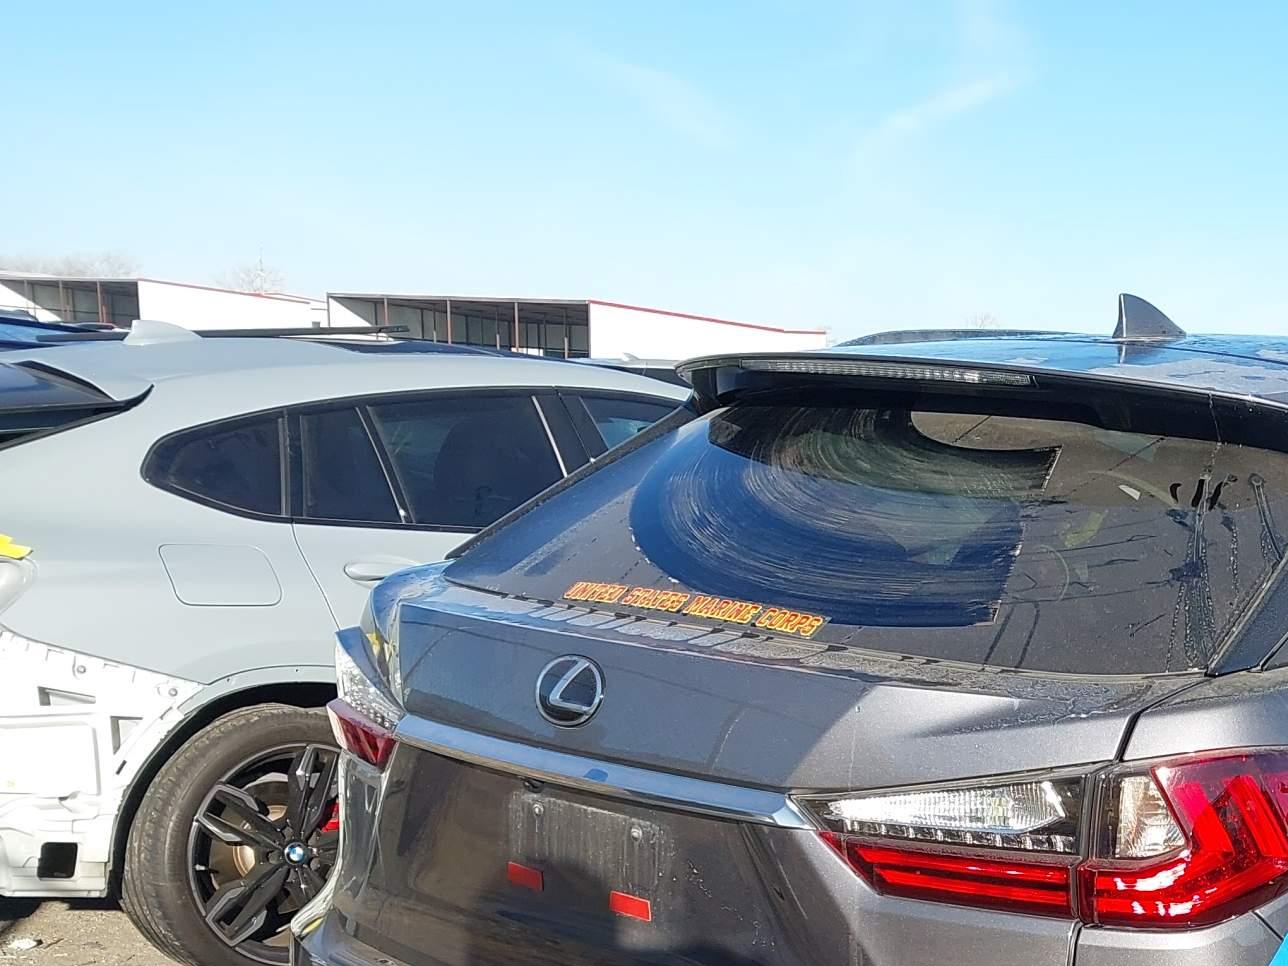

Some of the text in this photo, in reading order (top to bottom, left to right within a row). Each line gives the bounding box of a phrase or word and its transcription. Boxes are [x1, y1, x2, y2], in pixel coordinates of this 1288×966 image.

[563, 581, 824, 637] UNITED STATES MARINE CORPS
